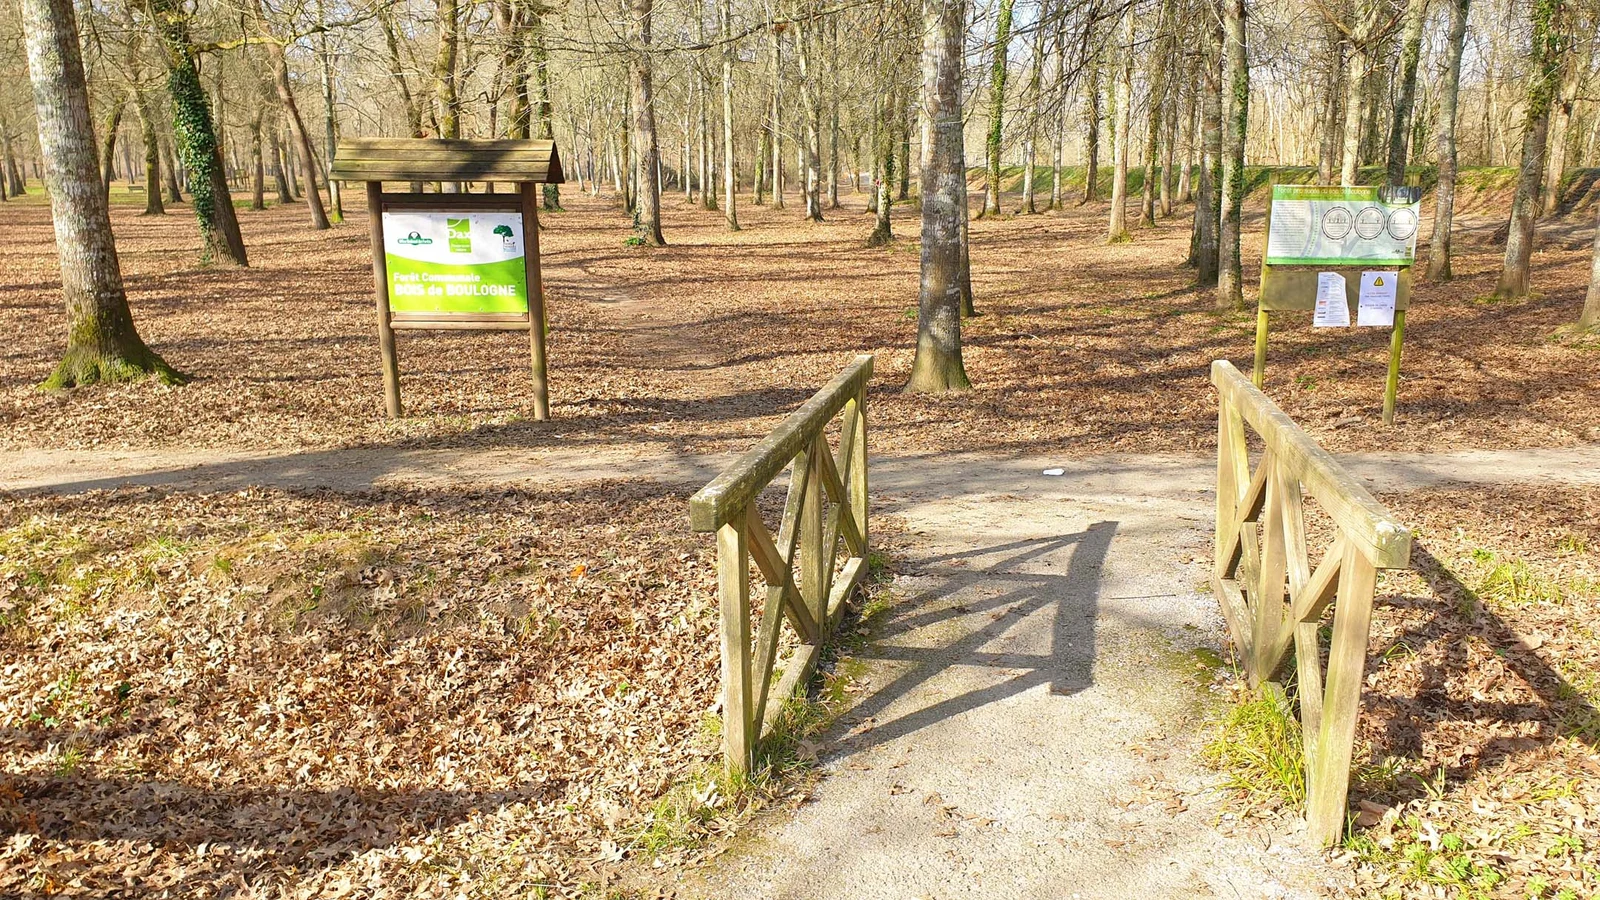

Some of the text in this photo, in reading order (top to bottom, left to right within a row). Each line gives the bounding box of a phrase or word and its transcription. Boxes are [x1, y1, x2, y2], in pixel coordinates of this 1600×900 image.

[446, 229, 471, 239] Dax
[393, 272, 481, 282] Forêt Communale
[394, 284, 516, 297] BOIS de BOULOGNE
